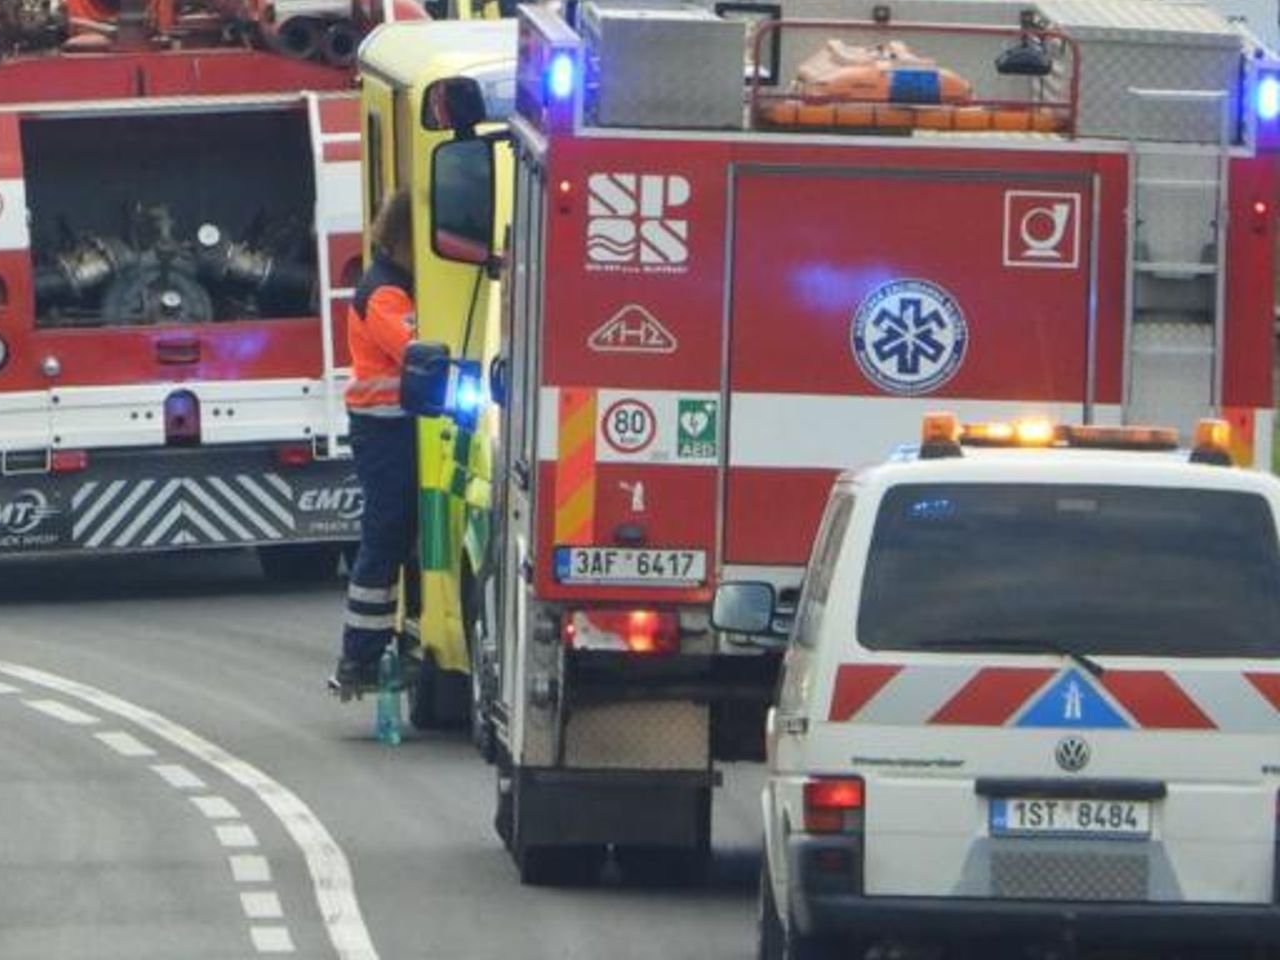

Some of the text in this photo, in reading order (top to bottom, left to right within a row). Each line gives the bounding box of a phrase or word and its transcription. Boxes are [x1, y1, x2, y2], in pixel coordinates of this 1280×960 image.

[615, 409, 646, 434] 80
[681, 444, 715, 457] AED
[576, 551, 694, 576] 3AF 6417
[1015, 802, 1137, 828] 1ST 8484
